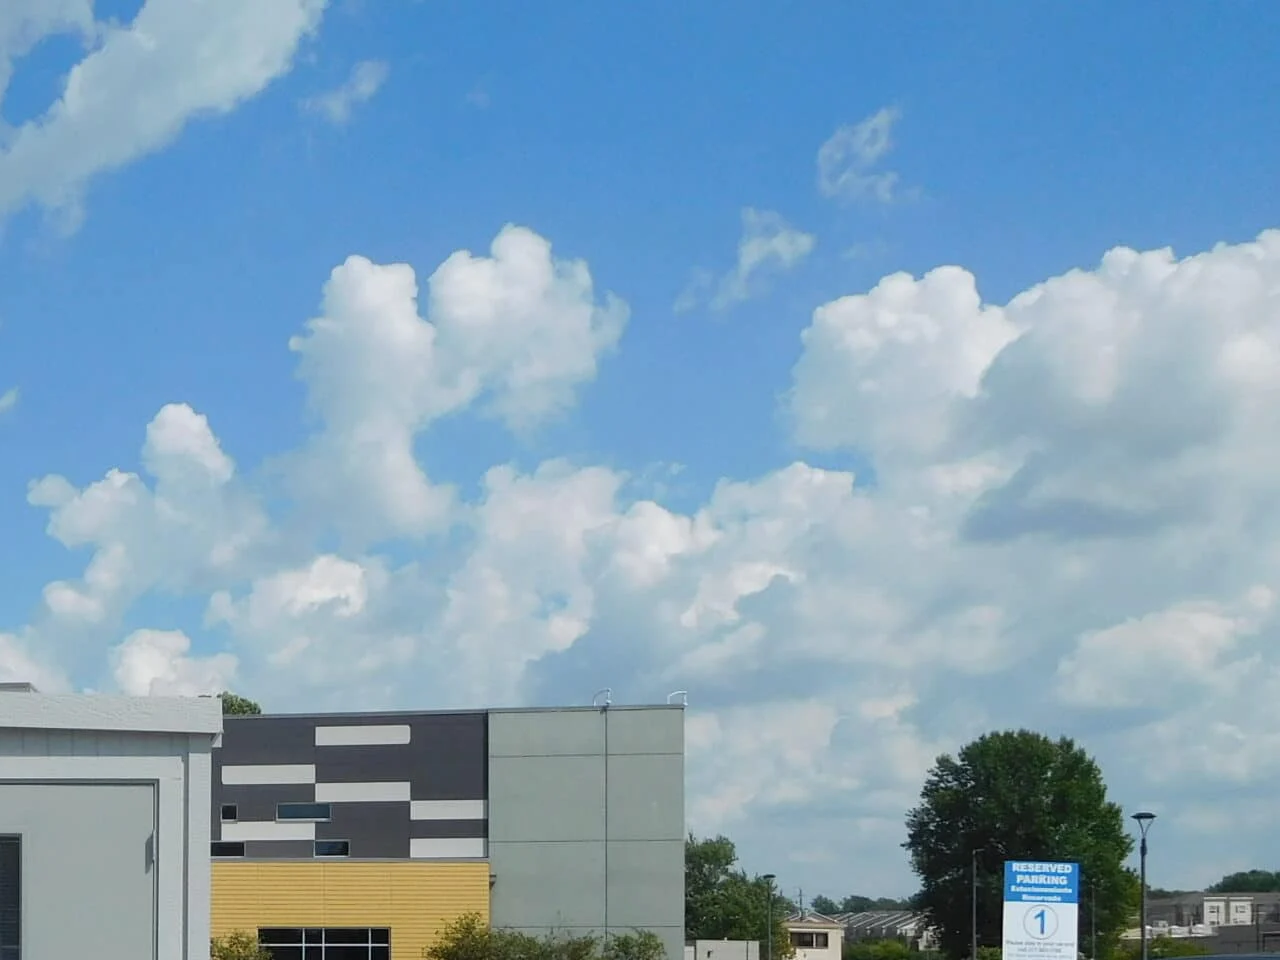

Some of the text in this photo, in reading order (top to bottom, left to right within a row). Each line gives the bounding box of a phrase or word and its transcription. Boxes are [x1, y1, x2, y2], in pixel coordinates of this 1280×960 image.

[1012, 862, 1072, 873] RESERVED
[1016, 874, 1068, 885] PARKING
[1034, 908, 1045, 935] 1
